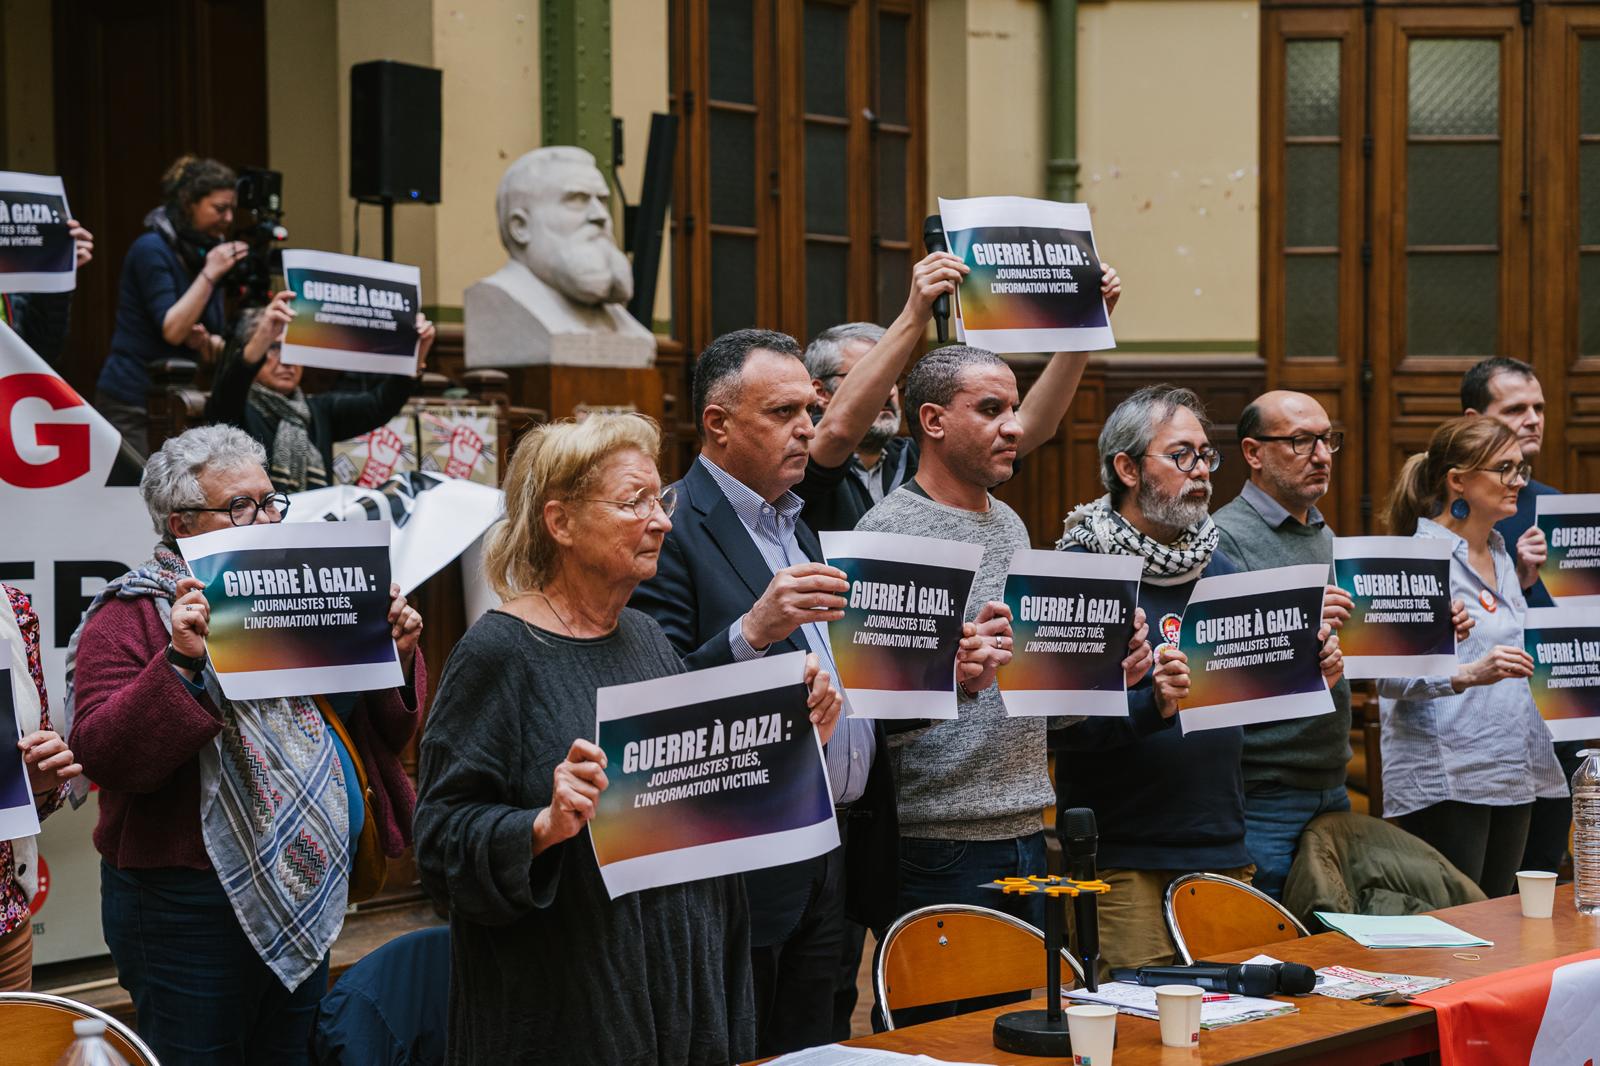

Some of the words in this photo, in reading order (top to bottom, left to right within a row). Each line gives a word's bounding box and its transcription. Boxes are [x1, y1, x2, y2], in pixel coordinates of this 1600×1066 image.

[971, 243, 1032, 266] GUERRE
[1032, 240, 1045, 266] À
[996, 268, 1051, 279] JOURNALISTES
[1052, 266, 1073, 280] TUÉS,
[303, 280, 357, 305] GUERRE
[358, 284, 369, 306] À
[991, 282, 1048, 294] L'INFORMATION
[1049, 282, 1078, 293] VICTIME
[1551, 526, 1600, 547] GUERRE
[222, 568, 301, 597] GUERRE
[302, 563, 318, 594] À
[1353, 574, 1399, 596] GUERRE
[1400, 571, 1410, 596] À
[251, 598, 325, 613] JOURNALISTES
[325, 594, 353, 609] TUÉS,
[849, 580, 905, 613] GUERRE
[905, 580, 916, 613] À
[1020, 595, 1075, 623] GUERRE
[1074, 593, 1085, 623] À
[1370, 598, 1415, 610] JOURNALISTES
[1415, 596, 1431, 610] TUÉS,
[244, 614, 320, 630] L'INFORMATION
[320, 612, 358, 626] VICTIME
[864, 614, 919, 631] JOURNALISTES
[919, 616, 938, 634] TUÉS,
[1195, 613, 1252, 644] GUERRE
[1254, 608, 1265, 636] À
[1364, 612, 1410, 623] L'INFORMATION
[1411, 612, 1434, 622] VICTIME
[852, 631, 912, 648] L'INFORMATION
[912, 635, 939, 649] VICTIME
[1034, 625, 1086, 638] JOURNALISTES
[1086, 624, 1105, 640] TUÉS,
[1024, 641, 1078, 653] L'INFORMATION
[1078, 642, 1106, 653] VICTIME
[1213, 638, 1269, 657] JOURNALISTES
[1270, 633, 1291, 648] TUÉS,
[1536, 642, 1575, 664] GUERRE
[1574, 638, 1583, 662] À
[1205, 653, 1264, 672] L'INFORMATION
[1264, 649, 1295, 663] VICTIME
[622, 727, 707, 774] GUERRE
[709, 719, 725, 757] À
[647, 757, 729, 788] JOURNALISTES
[731, 749, 761, 770] TUÉS,
[633, 778, 720, 808] L'INFORMATION
[722, 769, 770, 789] VICTIME
